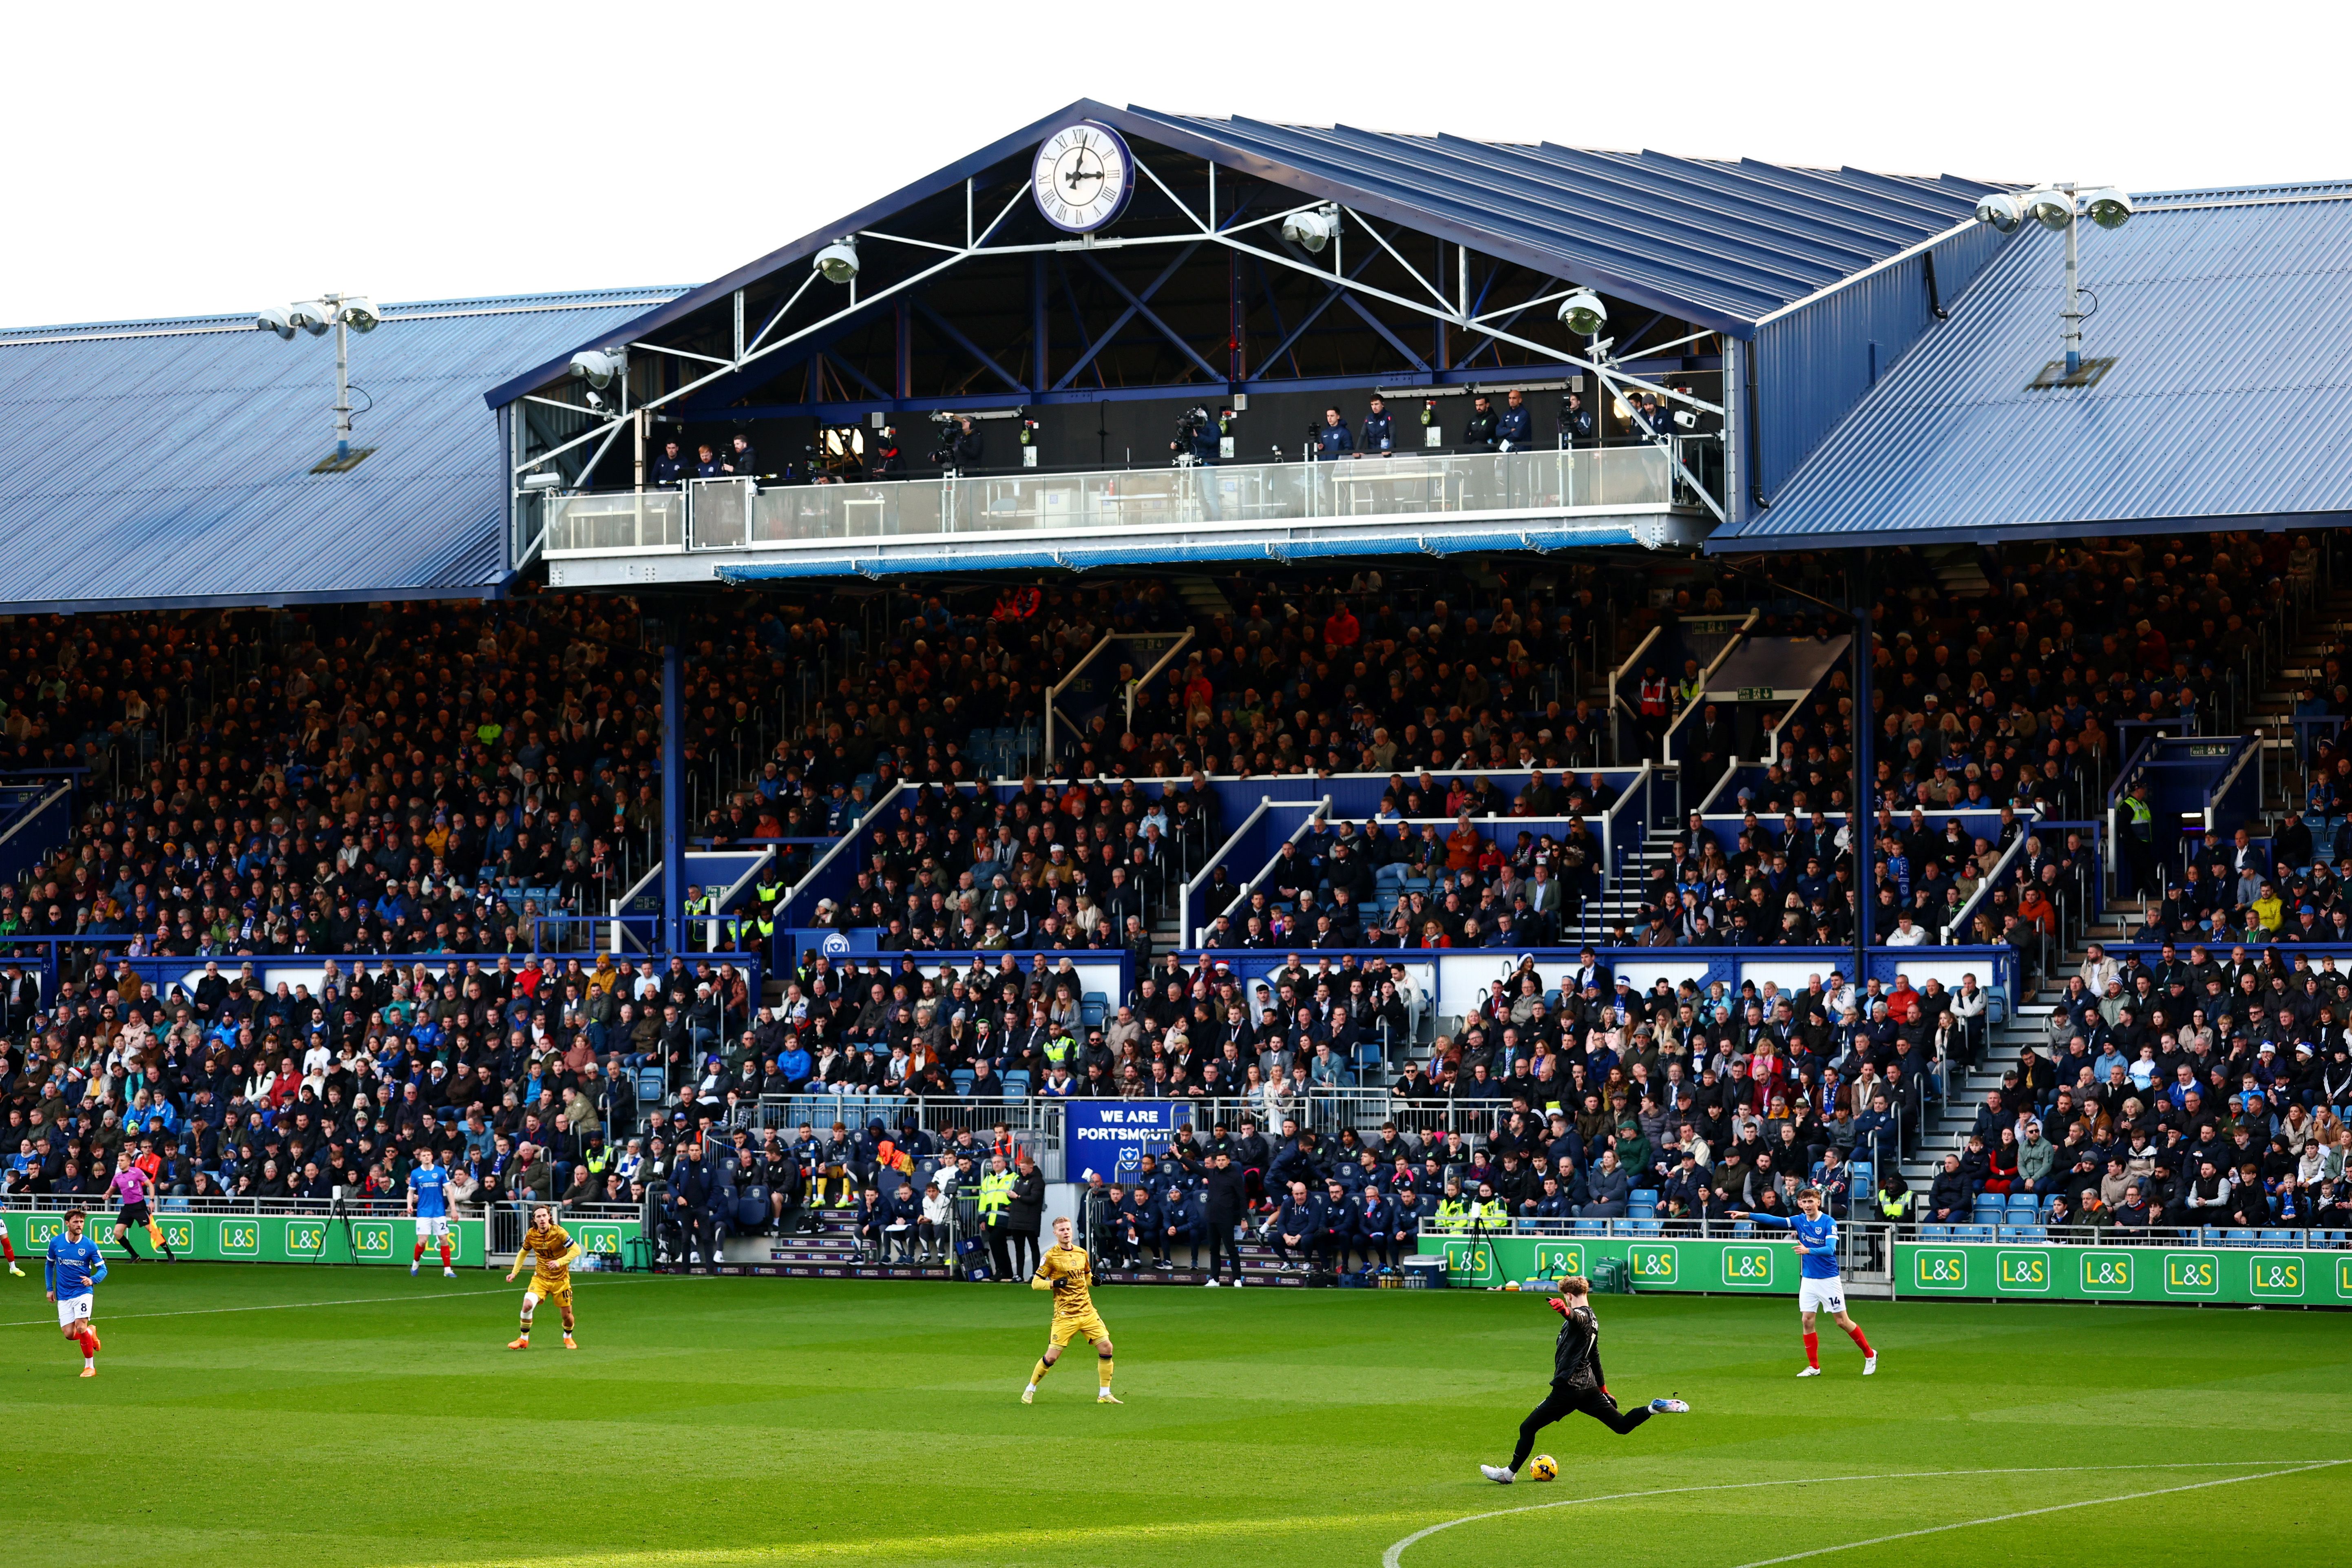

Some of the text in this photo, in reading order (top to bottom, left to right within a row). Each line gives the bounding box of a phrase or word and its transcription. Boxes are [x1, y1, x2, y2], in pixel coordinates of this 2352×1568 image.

[1043, 153, 1055, 164] X
[1100, 1110, 1158, 1123] WE ARE
[1078, 1128, 1180, 1141] PORTSMOUT
[94, 1226, 120, 1244] L&
[159, 1227, 188, 1246] &S
[224, 1228, 254, 1247] L&S
[290, 1230, 321, 1248] L&S
[357, 1231, 388, 1250] L&S
[584, 1234, 616, 1253] L&S
[1449, 1250, 1486, 1271] L&S
[1634, 1254, 1671, 1275] L&S
[1729, 1256, 1766, 1277] L&S
[1921, 1259, 1960, 1280] L&S
[2003, 1261, 2043, 1282] L&S
[2087, 1262, 2127, 1284] L&S
[2171, 1263, 2211, 1286] L&S
[2257, 1265, 2297, 1288] L&S
[81, 1303, 87, 1312] 8
[1829, 1296, 1840, 1307] 14
